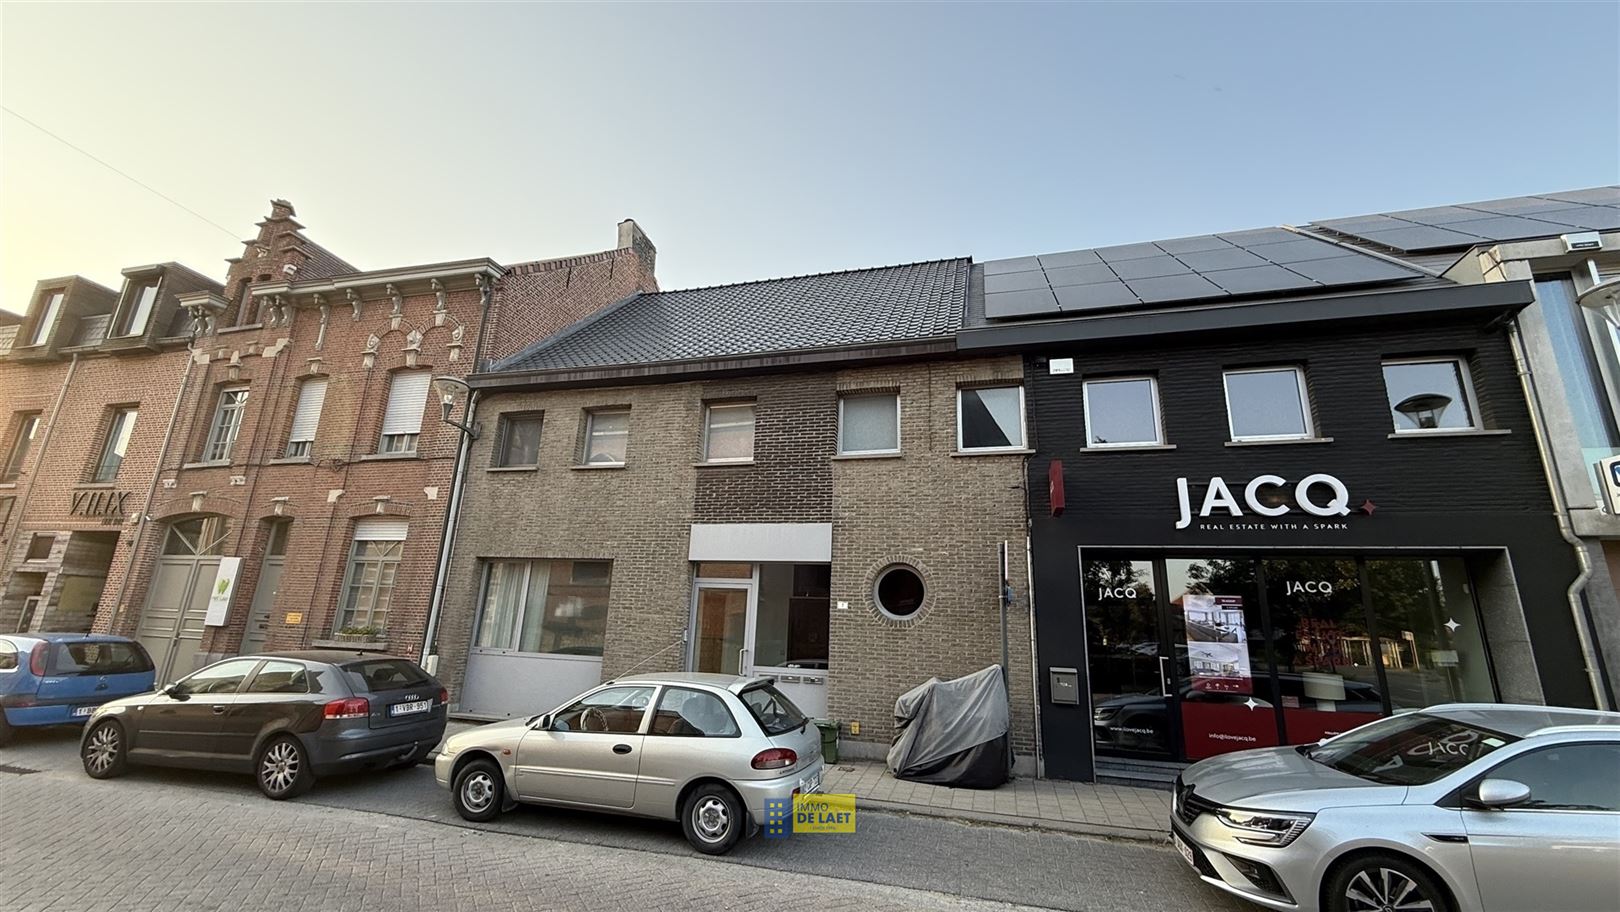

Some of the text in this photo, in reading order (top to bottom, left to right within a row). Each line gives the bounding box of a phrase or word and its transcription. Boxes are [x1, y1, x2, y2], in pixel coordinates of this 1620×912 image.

[1175, 473, 1351, 529] JACQ
[1098, 587, 1137, 601] JACQ
[1286, 580, 1333, 596] JACQ
[1109, 726, 1154, 735] www.ilovejacq.be
[1208, 732, 1257, 742] info@ilovejacq.be
